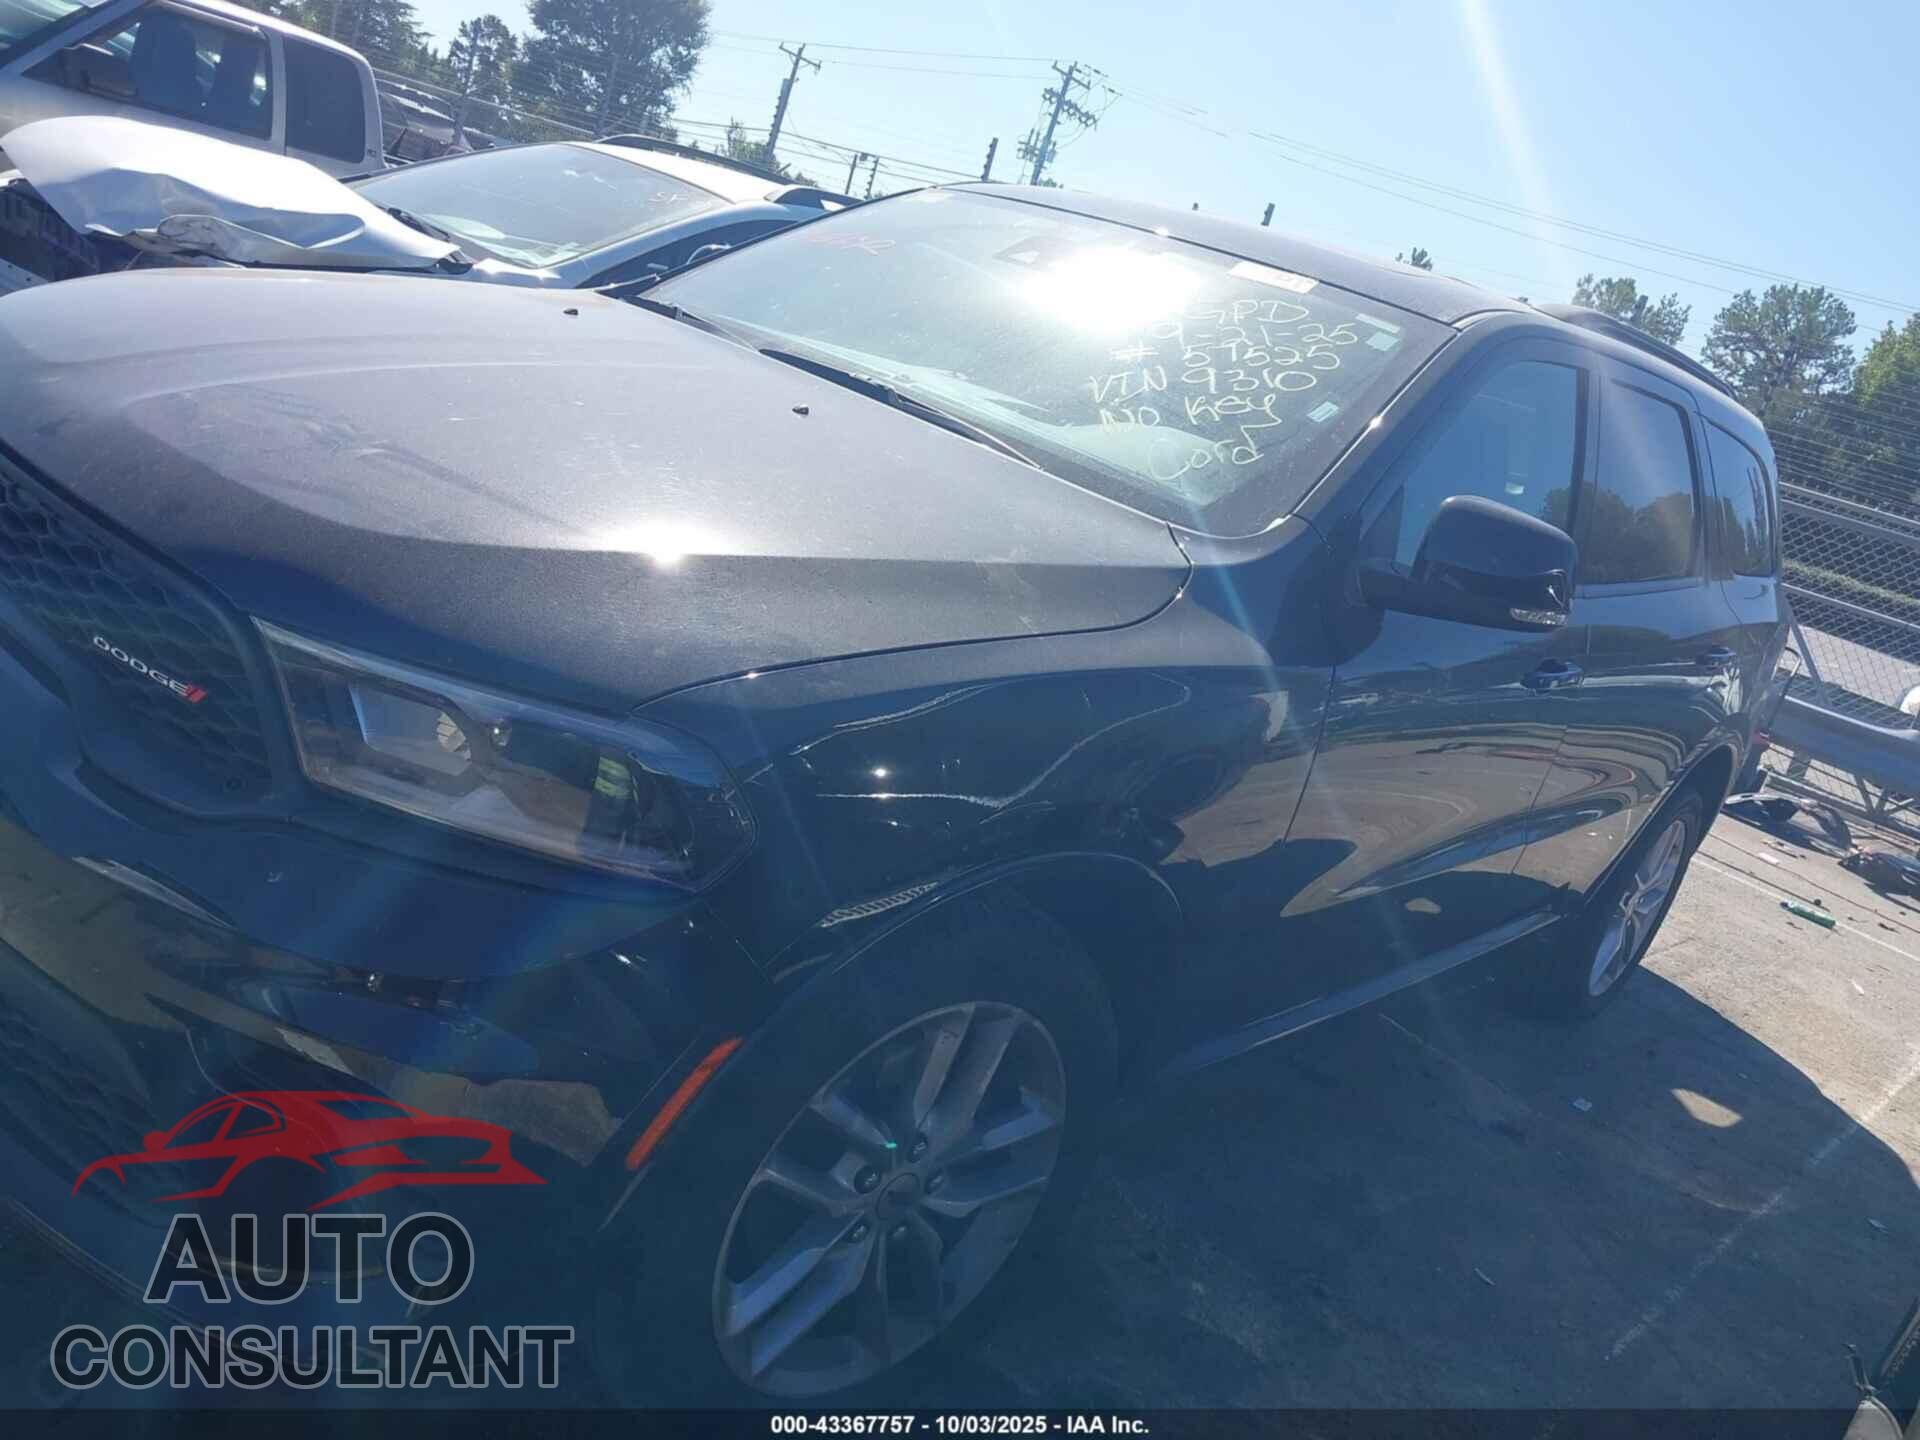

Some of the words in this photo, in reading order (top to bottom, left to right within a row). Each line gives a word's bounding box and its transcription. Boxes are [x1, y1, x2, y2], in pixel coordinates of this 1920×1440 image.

[1151, 319, 1359, 349] 9-21-25
[1089, 365, 1168, 405] VIN
[1181, 366, 1317, 394] 9310
[93, 636, 189, 697] DODGE
